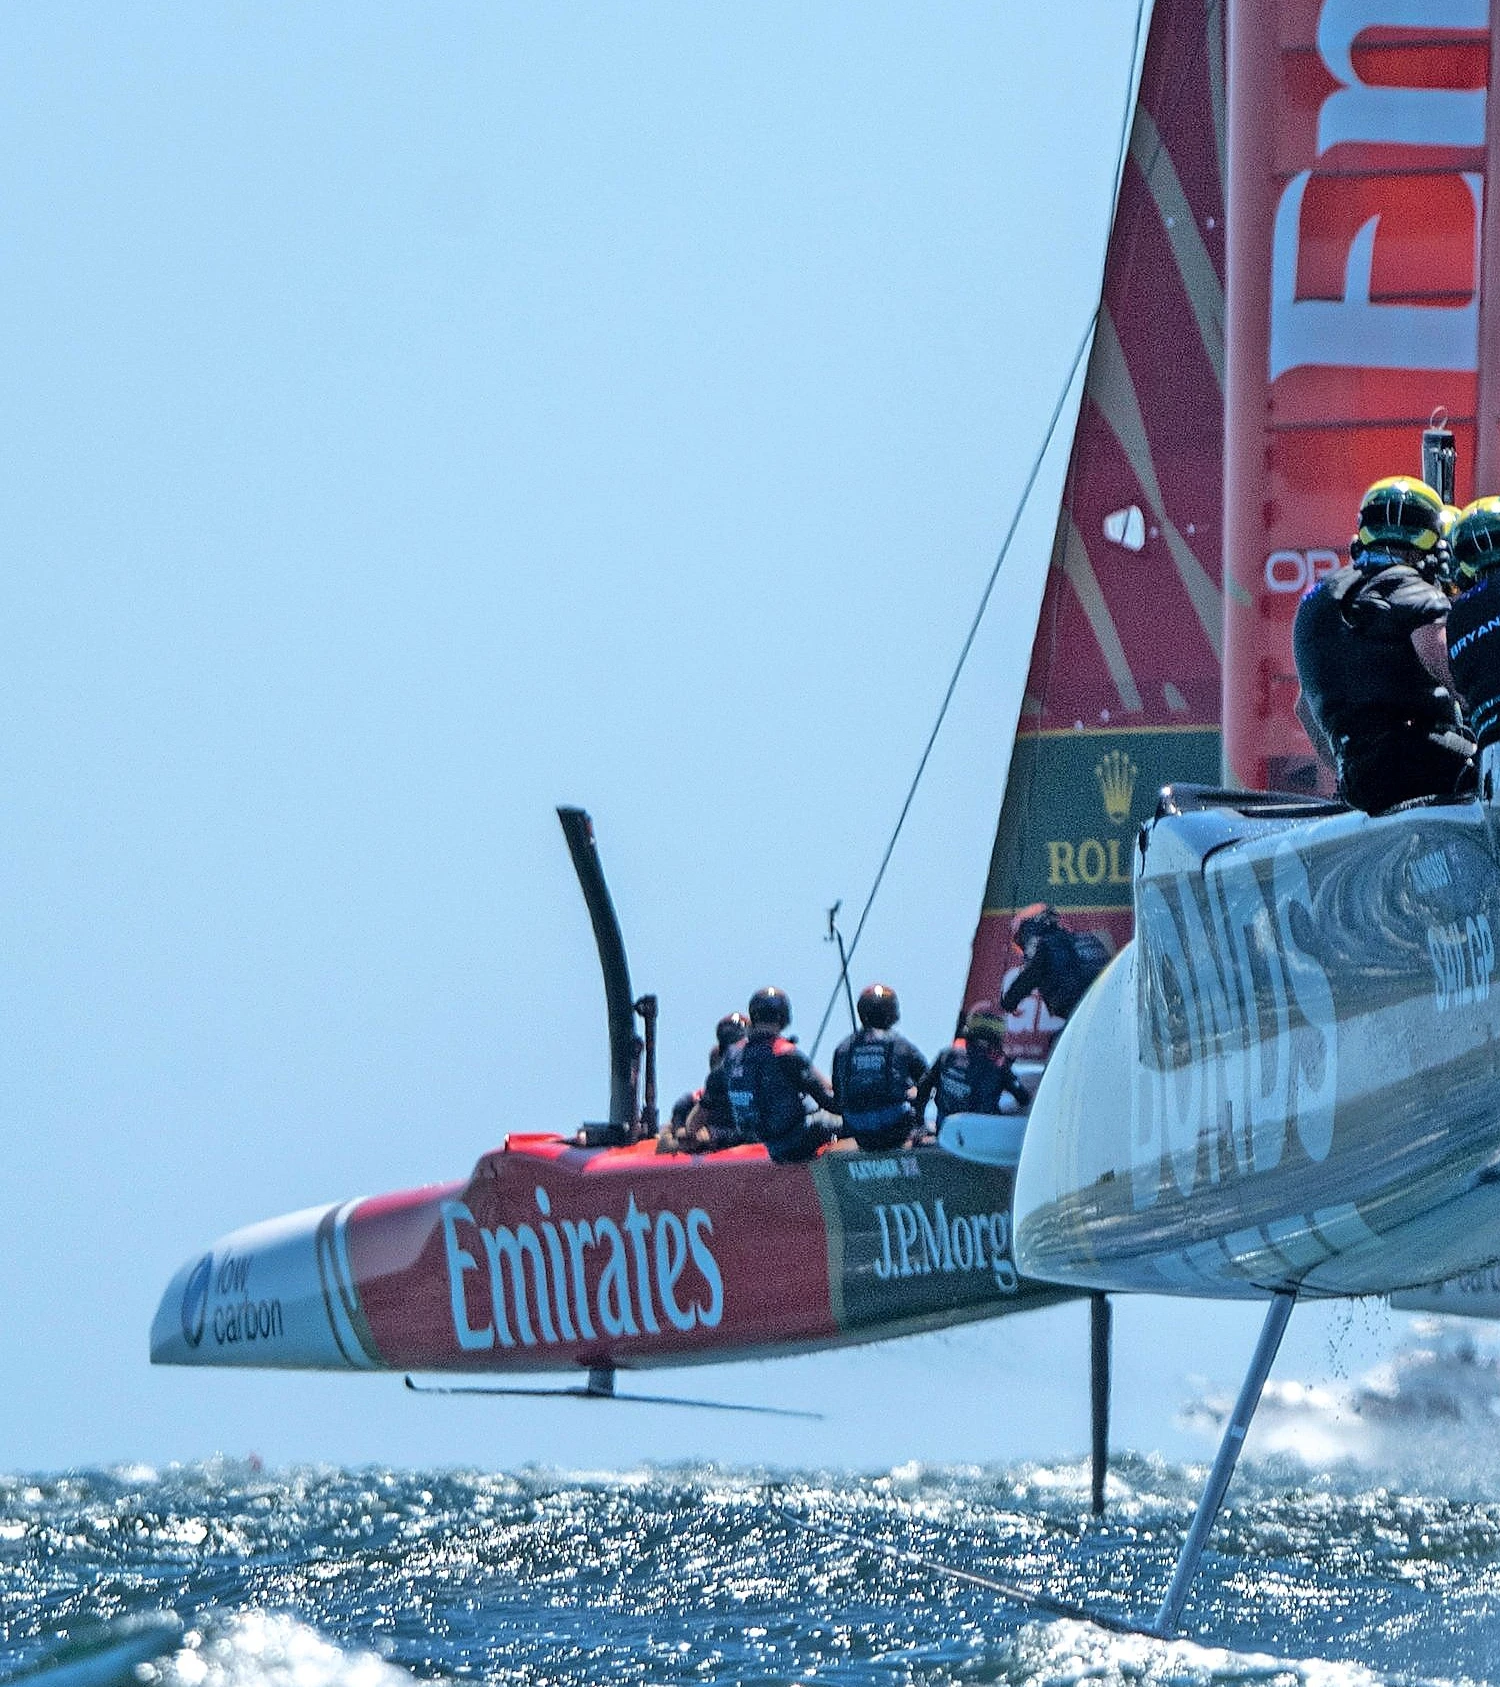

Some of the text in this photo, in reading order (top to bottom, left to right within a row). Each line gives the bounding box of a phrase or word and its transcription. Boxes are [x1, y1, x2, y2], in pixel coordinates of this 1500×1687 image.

[213, 1248, 248, 1296] low
[442, 1185, 724, 1352] Emirates
[212, 1296, 283, 1346] carbon
